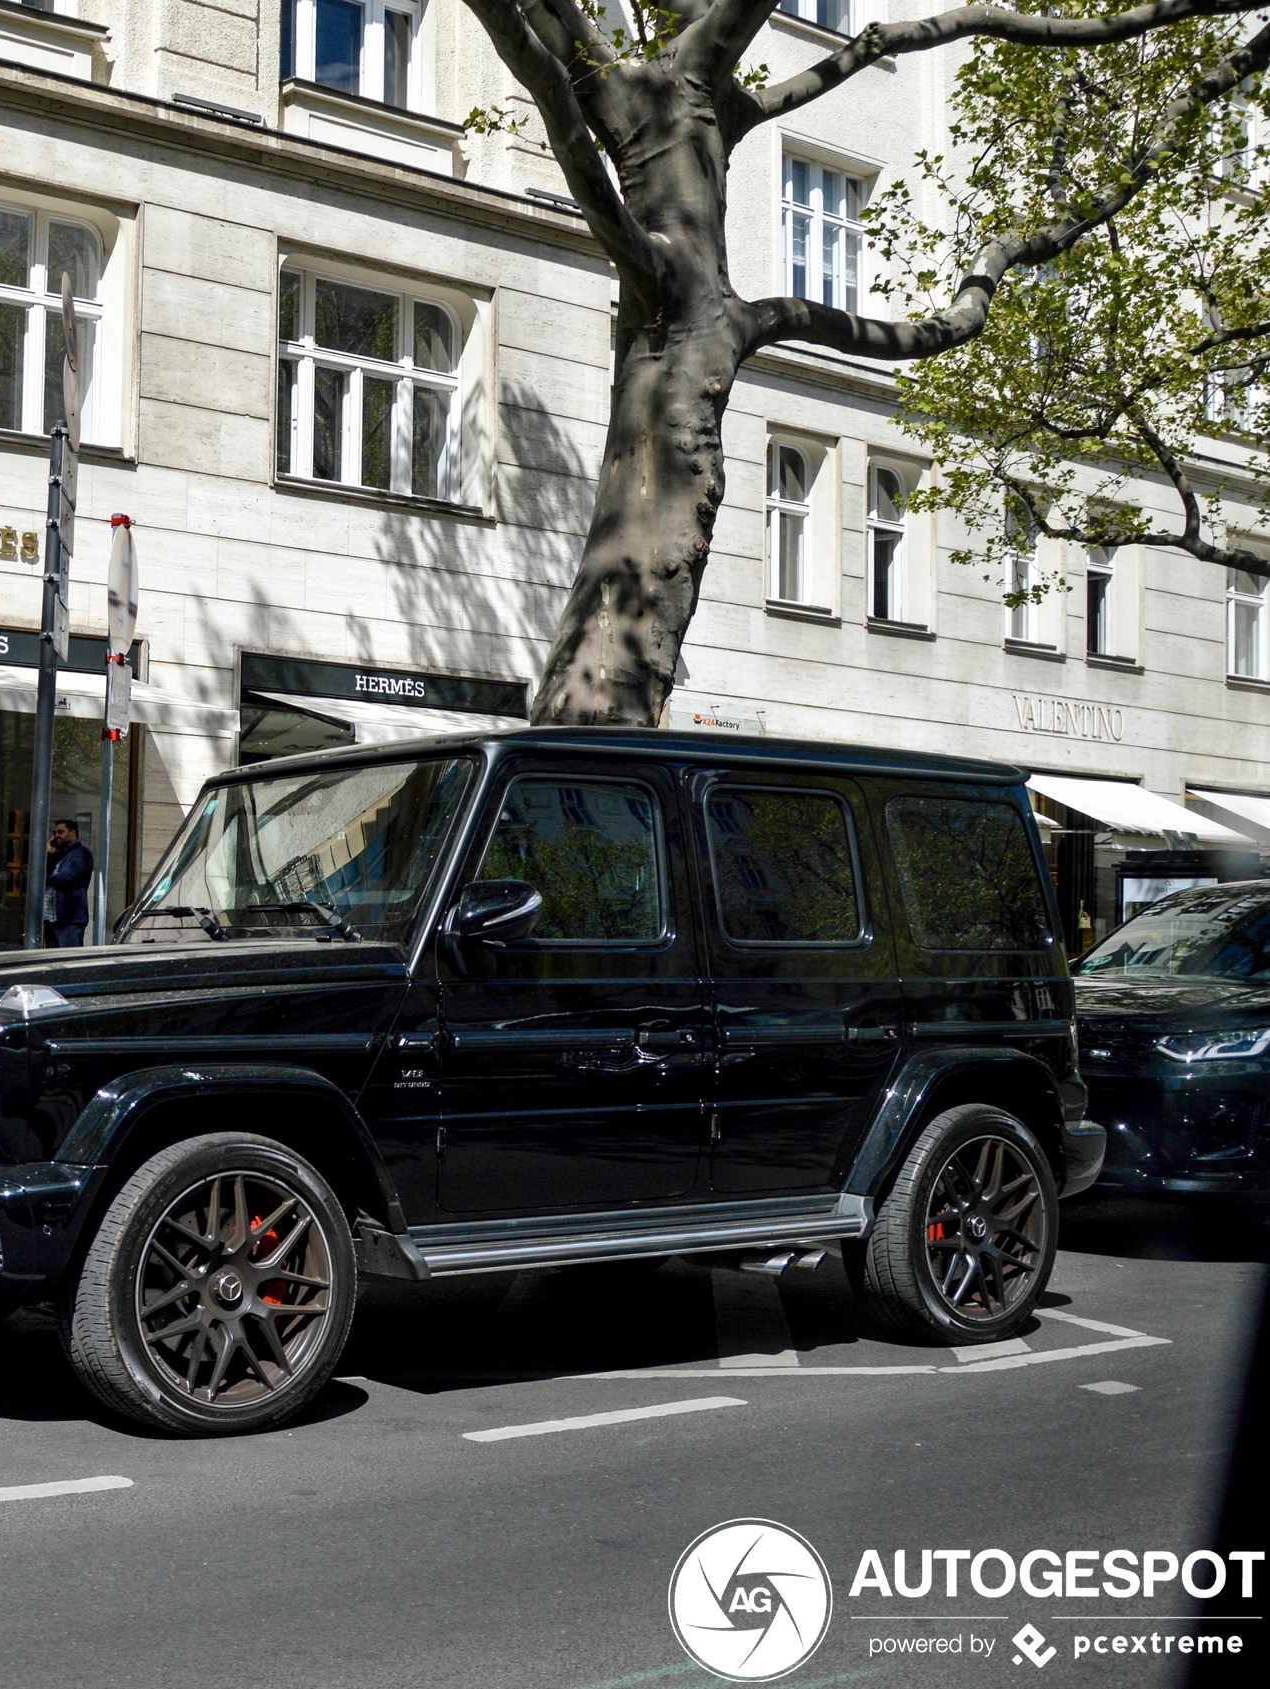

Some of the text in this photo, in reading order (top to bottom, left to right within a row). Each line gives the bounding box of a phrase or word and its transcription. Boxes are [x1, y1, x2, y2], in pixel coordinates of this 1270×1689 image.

[354, 674, 425, 698] HERMÈS
[1012, 695, 1125, 741] VALENTINO
[401, 1069, 424, 1078] V8
